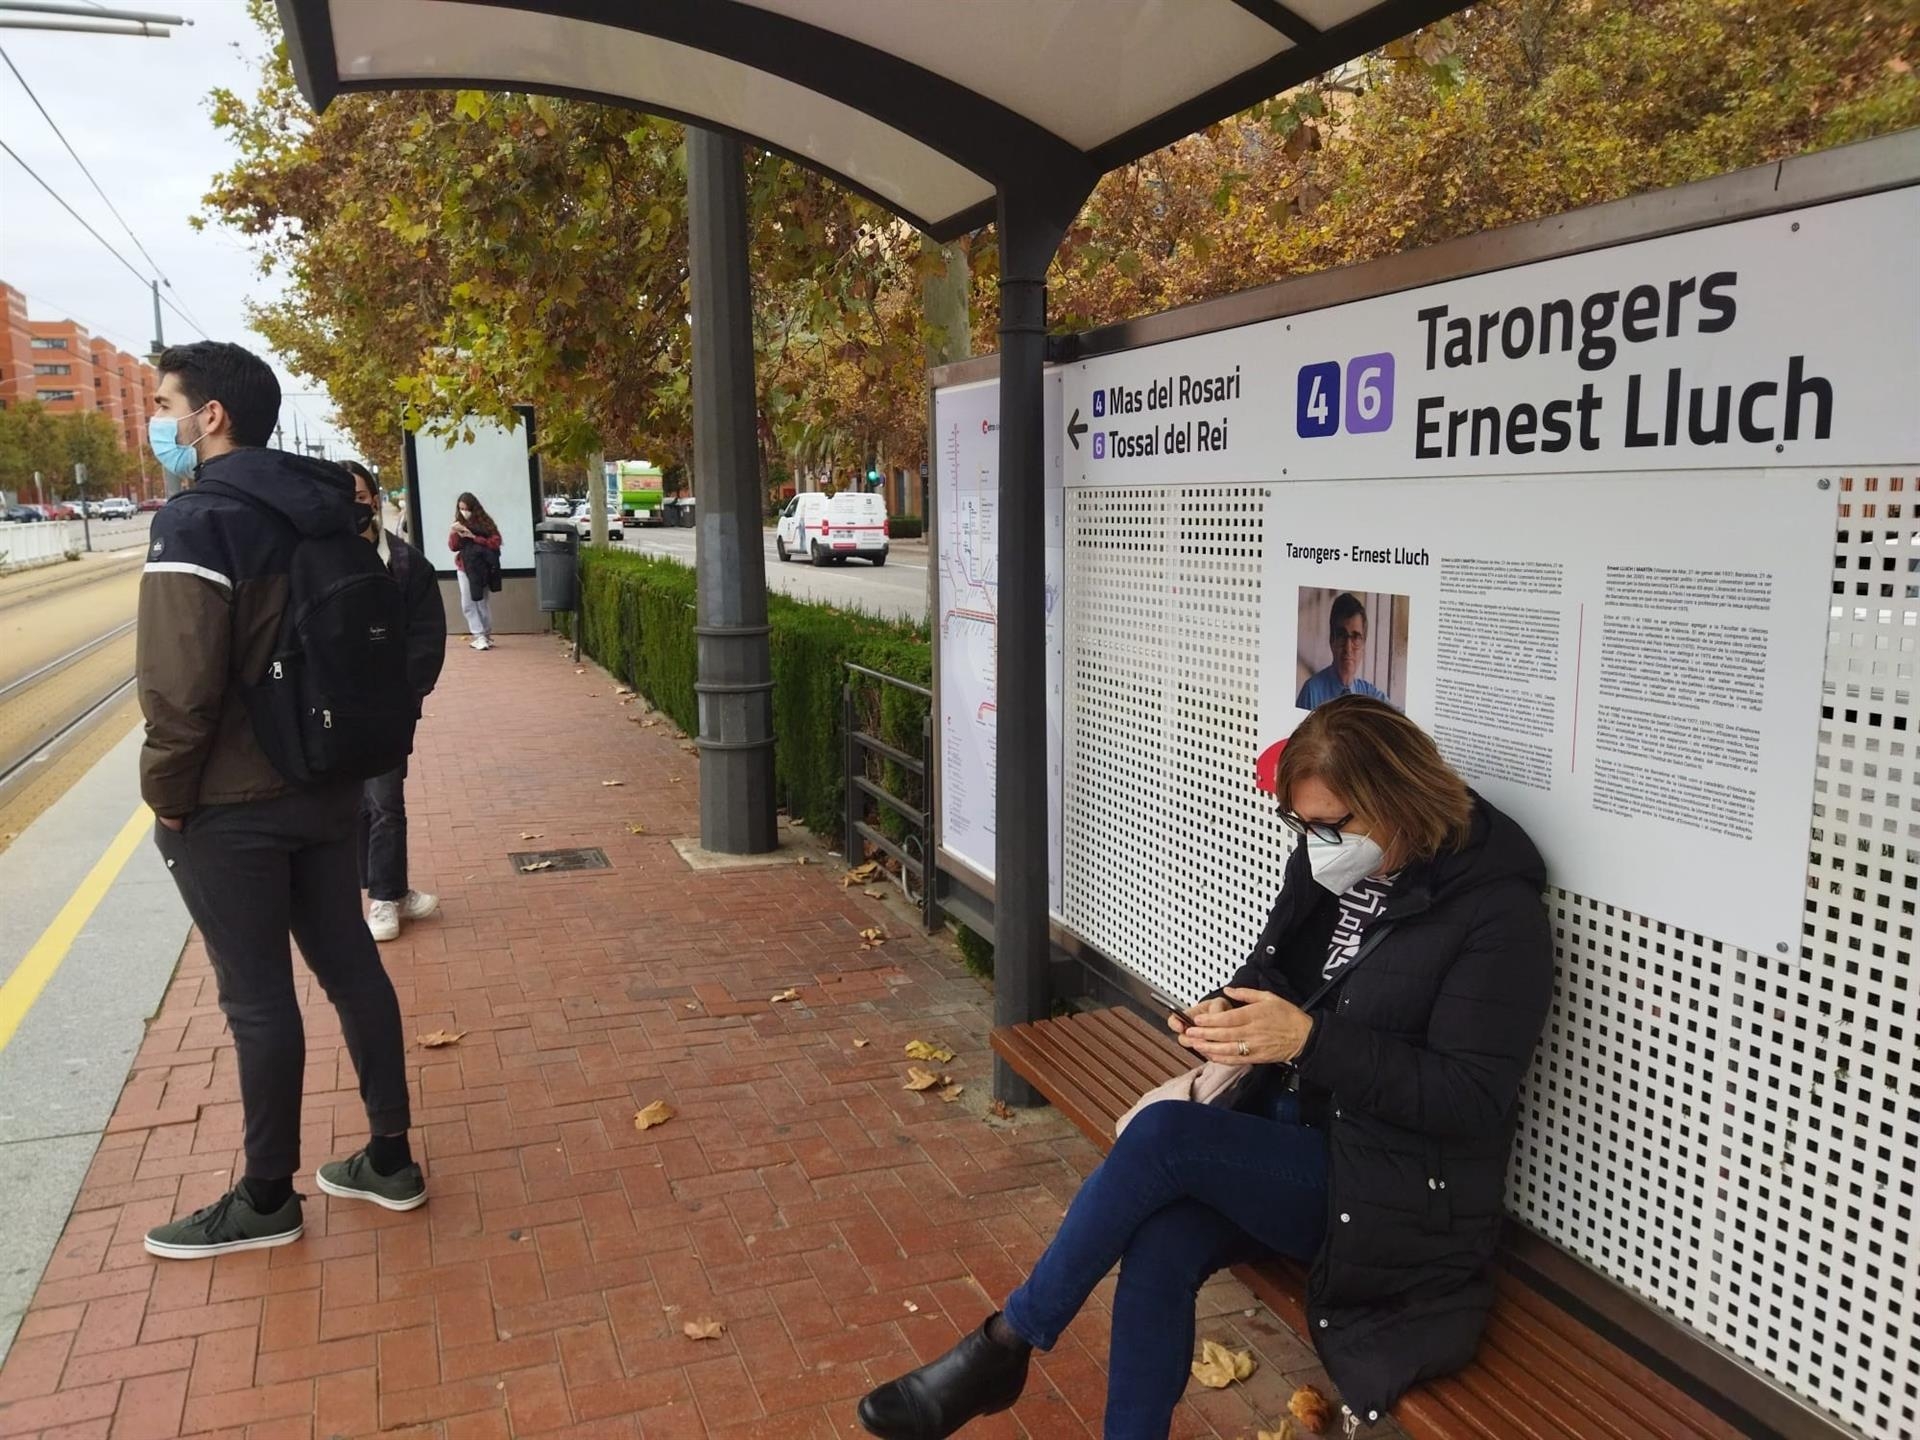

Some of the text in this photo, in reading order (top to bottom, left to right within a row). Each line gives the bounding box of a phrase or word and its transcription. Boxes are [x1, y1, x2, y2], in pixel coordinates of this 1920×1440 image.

[1417, 271, 1738, 372] Tarongers
[1110, 386, 1143, 415] Mas
[1147, 377, 1173, 411] del
[1179, 365, 1240, 406] Rosari
[1306, 366, 1382, 425] 4 6
[1415, 355, 1834, 459] Ernest Lluch
[1109, 425, 1159, 458] Tossal
[1164, 421, 1191, 454] del
[1198, 417, 1228, 452] Rei
[1286, 543, 1340, 564] Tarongers
[1352, 546, 1391, 564] Ernest
[1395, 547, 1430, 566] Lluch
